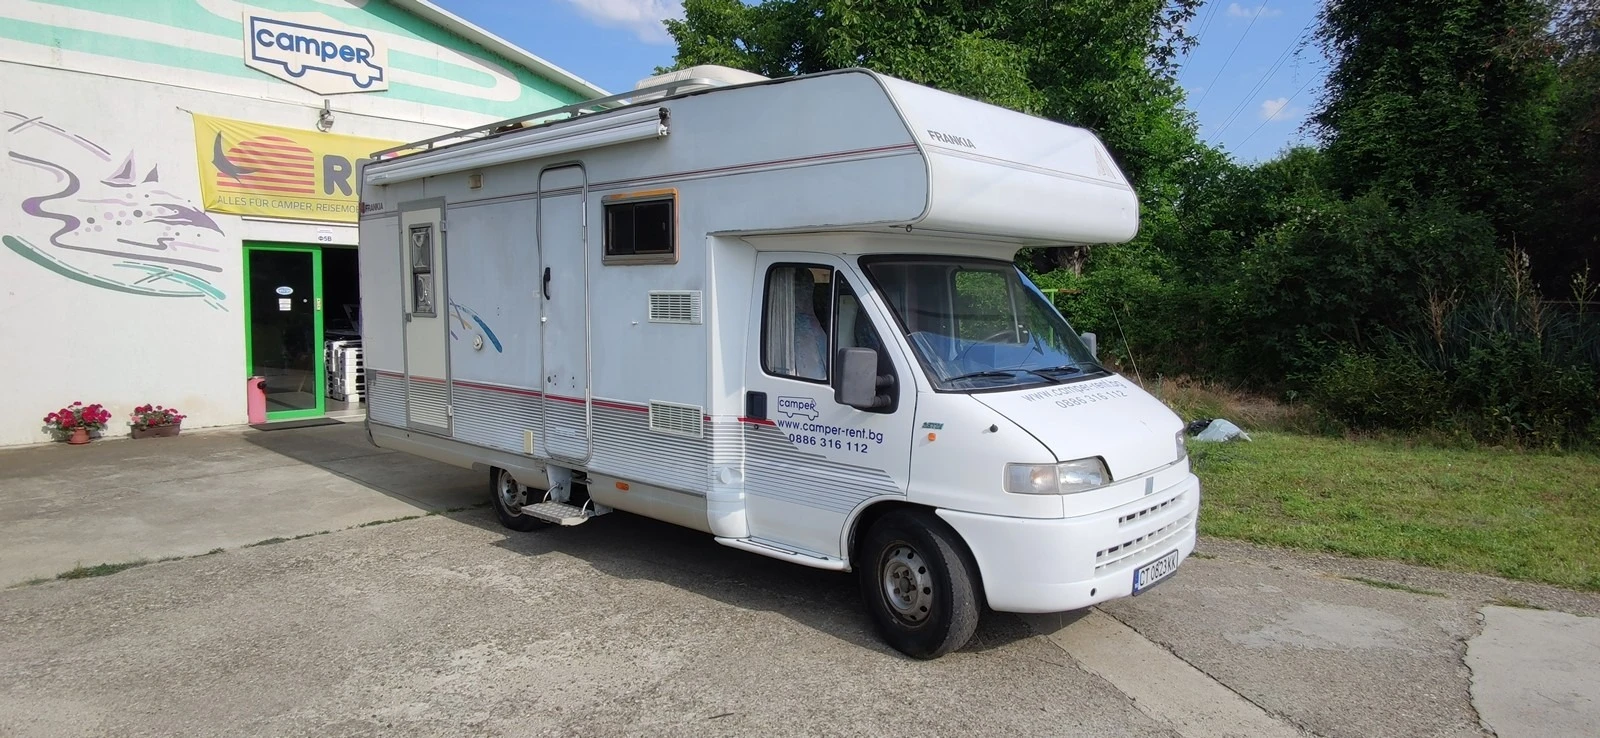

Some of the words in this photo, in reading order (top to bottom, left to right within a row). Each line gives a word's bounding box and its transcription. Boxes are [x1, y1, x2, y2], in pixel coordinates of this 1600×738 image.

[927, 129, 976, 149] FRANKIA
[217, 195, 247, 206] ALLES
[249, 196, 269, 208] FÜR
[271, 199, 314, 212] CAMPER,
[1021, 379, 1128, 402] www.camper-rent.bg
[1055, 396, 1088, 409] 0886
[1084, 392, 1108, 402] 316
[1106, 390, 1128, 400] 112
[777, 419, 884, 444] www.camper-rent.bg
[788, 433, 817, 446] 0886
[820, 438, 842, 449] 316
[847, 442, 868, 453] 112
